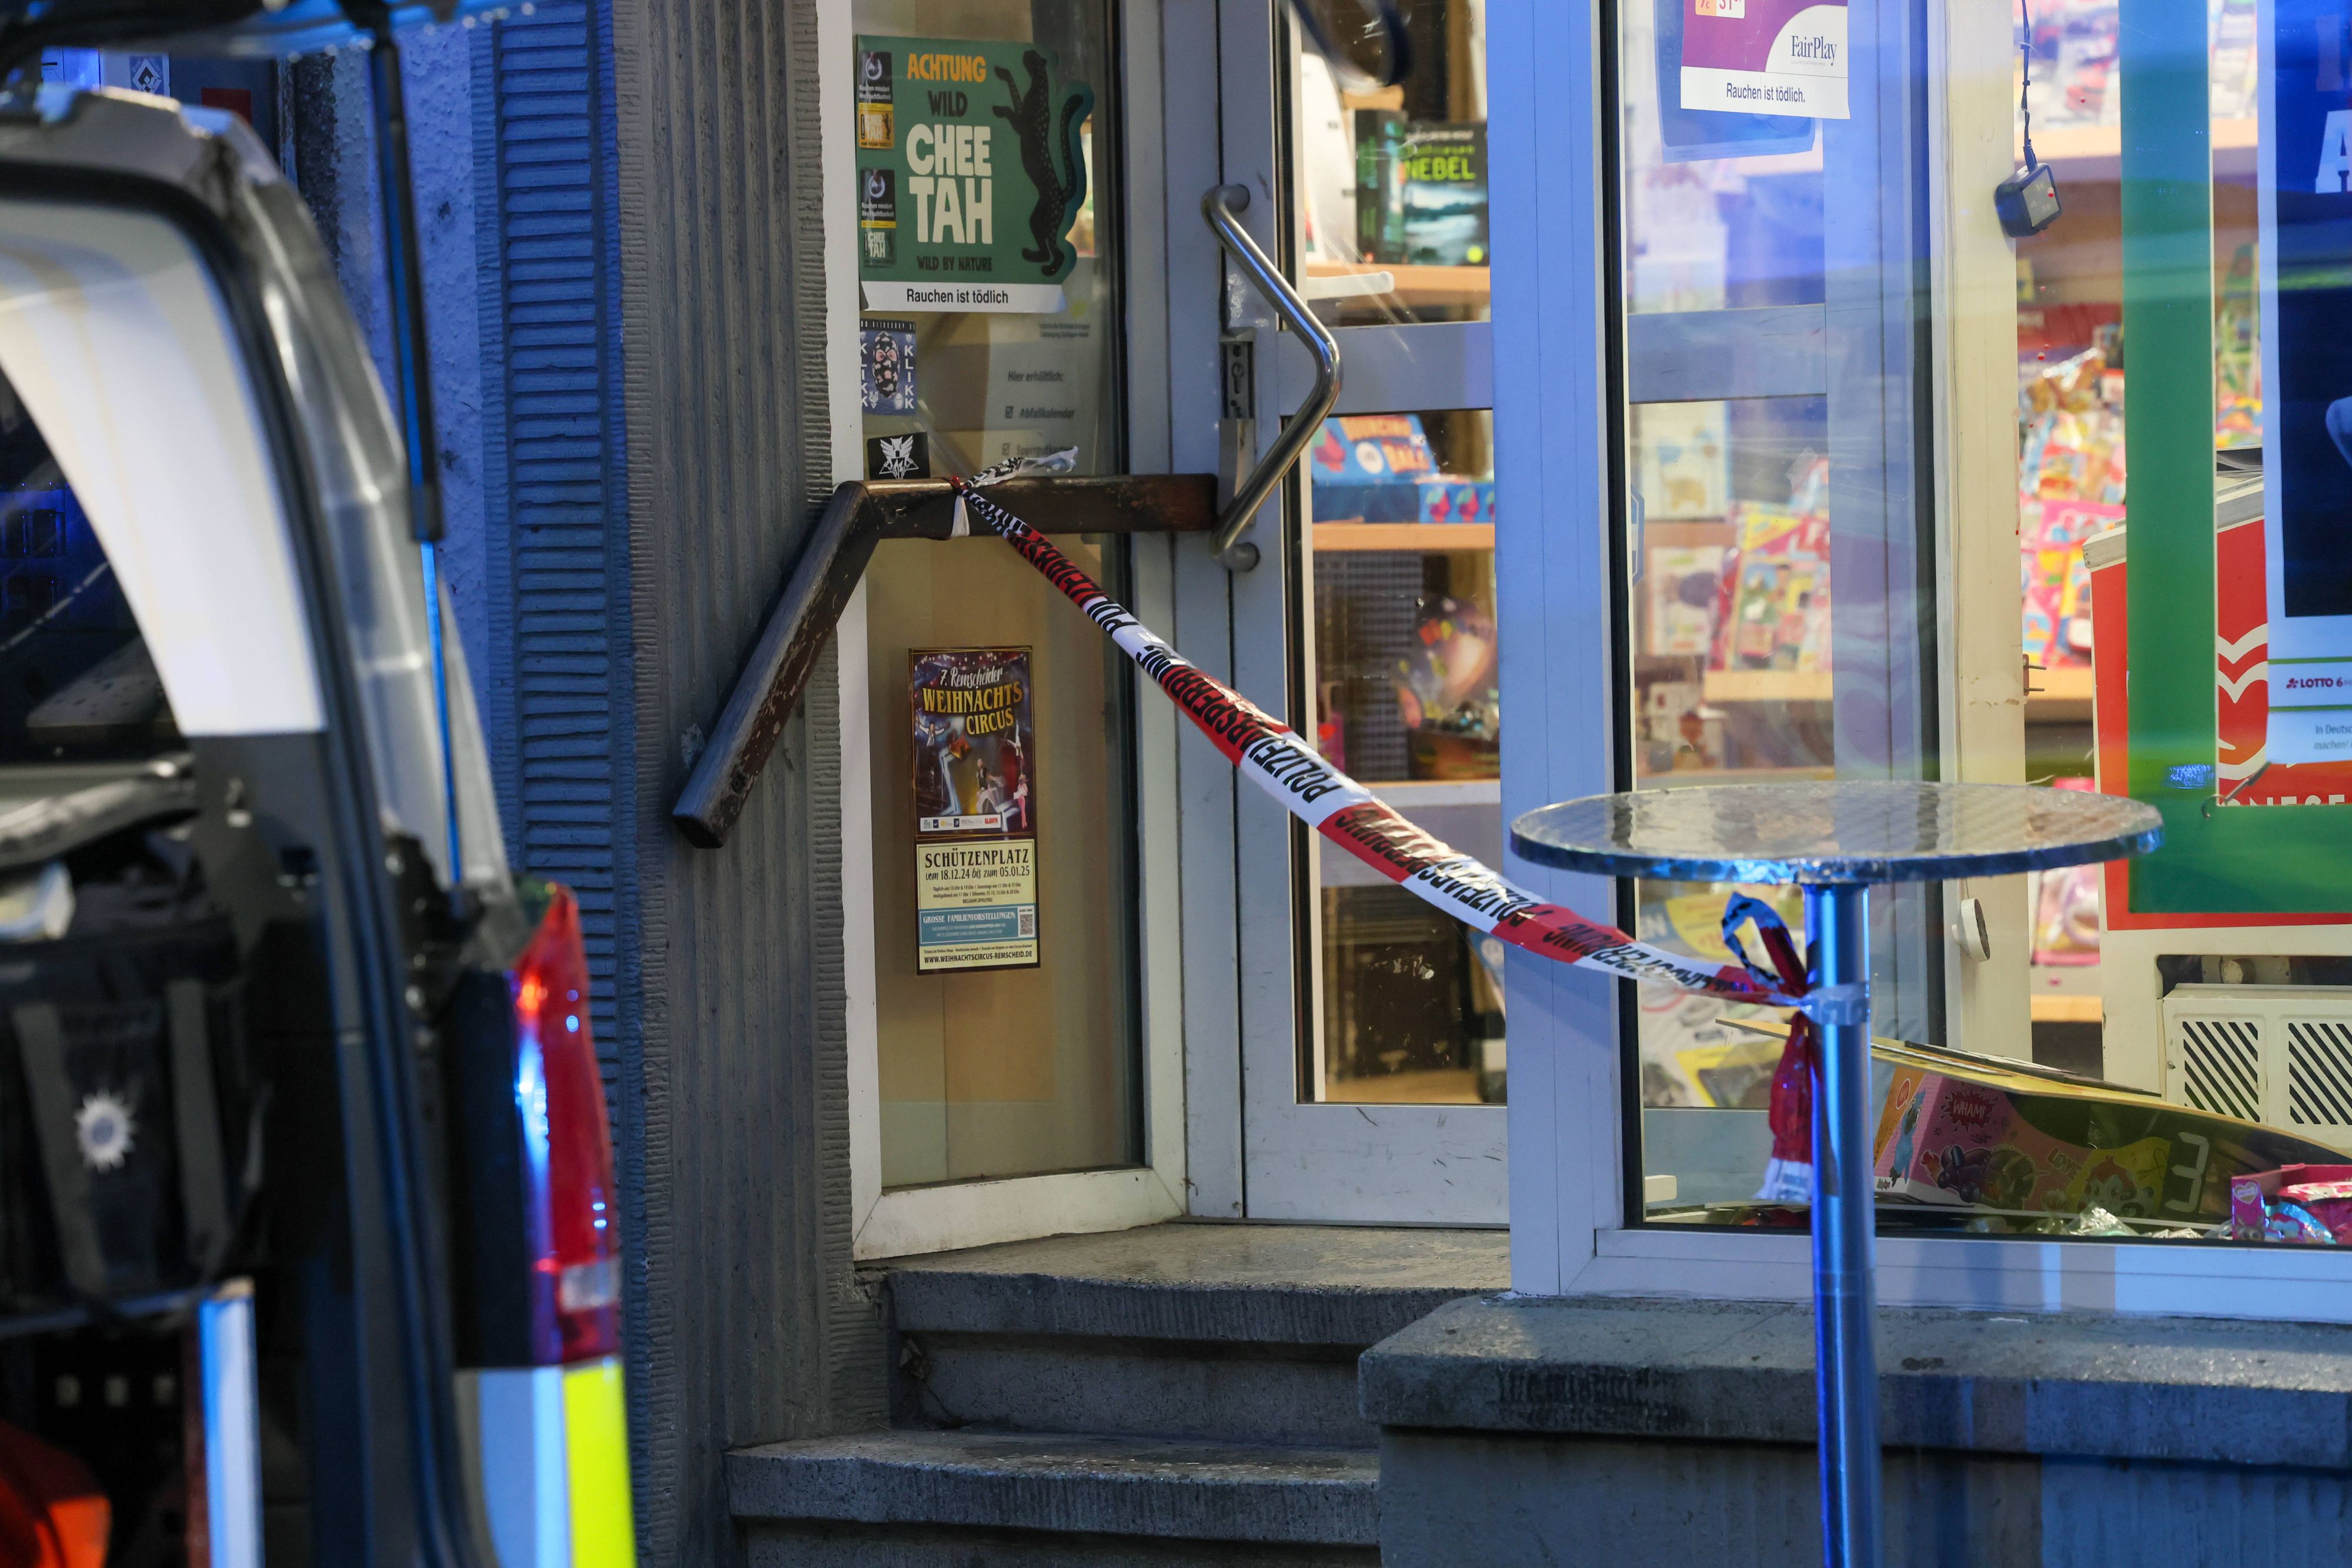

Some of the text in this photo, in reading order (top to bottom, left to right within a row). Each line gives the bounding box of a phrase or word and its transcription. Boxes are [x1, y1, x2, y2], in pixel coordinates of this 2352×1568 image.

[907, 53, 987, 82] ACHTUNG
[1726, 82, 1806, 102] Rauchen ist tödlich.
[927, 89, 968, 117] WILD
[906, 123, 992, 176] CHEE
[908, 176, 993, 244] TAH
[917, 255, 993, 272] WILD BY NATURE
[906, 289, 1008, 304] Rauchen ist tödlich
[940, 666, 1003, 688] 7. Remscheider
[2300, 678, 2333, 688] LOTTO
[2336, 677, 2343, 687] 6
[923, 680, 1023, 713] WEIHNACHTS
[965, 708, 1014, 735] CIRCUS
[2316, 725, 2324, 734] In
[925, 848, 1029, 868] SCHÜTZENPLATZ
[941, 868, 970, 880] 18.12.24
[972, 868, 981, 879] bis
[984, 870, 998, 878] zum
[1000, 865, 1030, 877] 05.01.25
[924, 950, 1033, 964] WWW.WEIHNACHTSCIRCUS-REMSCHEID.DE
